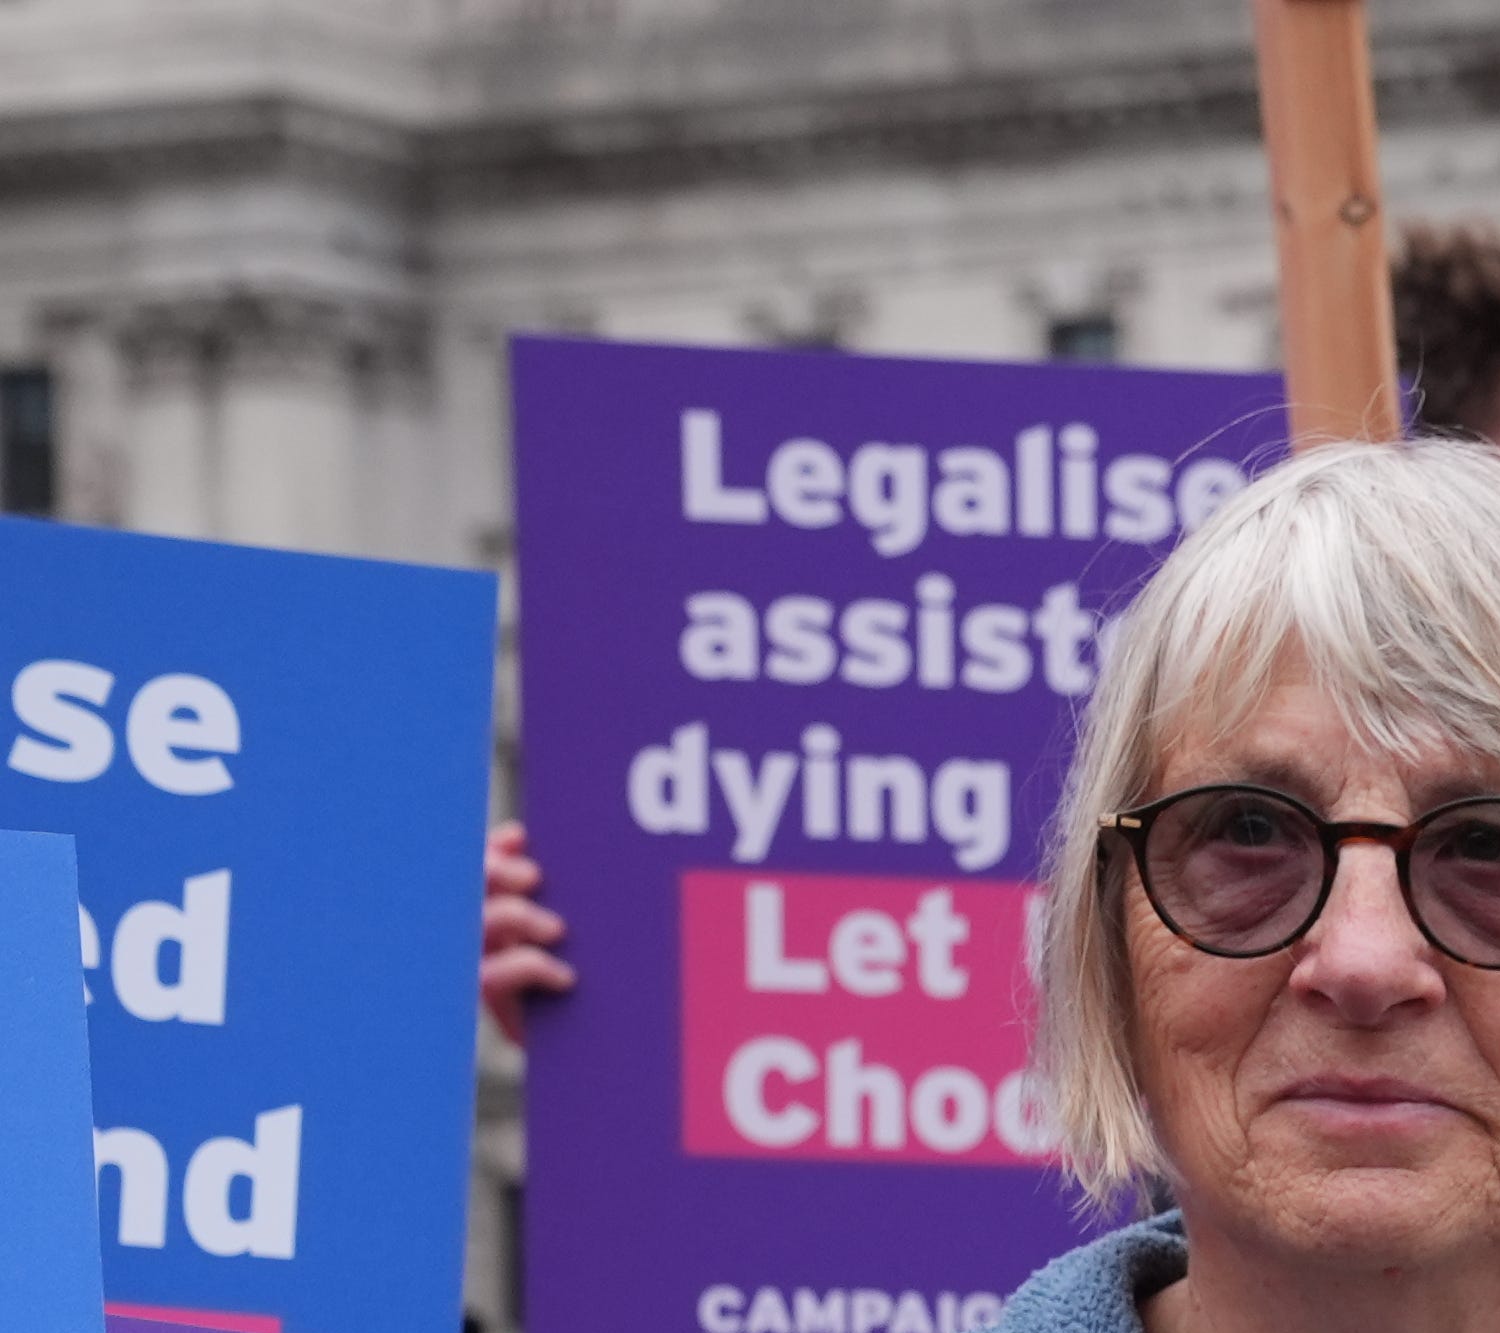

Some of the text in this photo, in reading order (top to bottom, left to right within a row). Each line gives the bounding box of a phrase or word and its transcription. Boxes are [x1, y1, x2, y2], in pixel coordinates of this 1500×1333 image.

[679, 570, 1112, 696] assist
[629, 724, 1009, 870] dying
[78, 868, 231, 1026] d
[746, 883, 968, 998] Let
